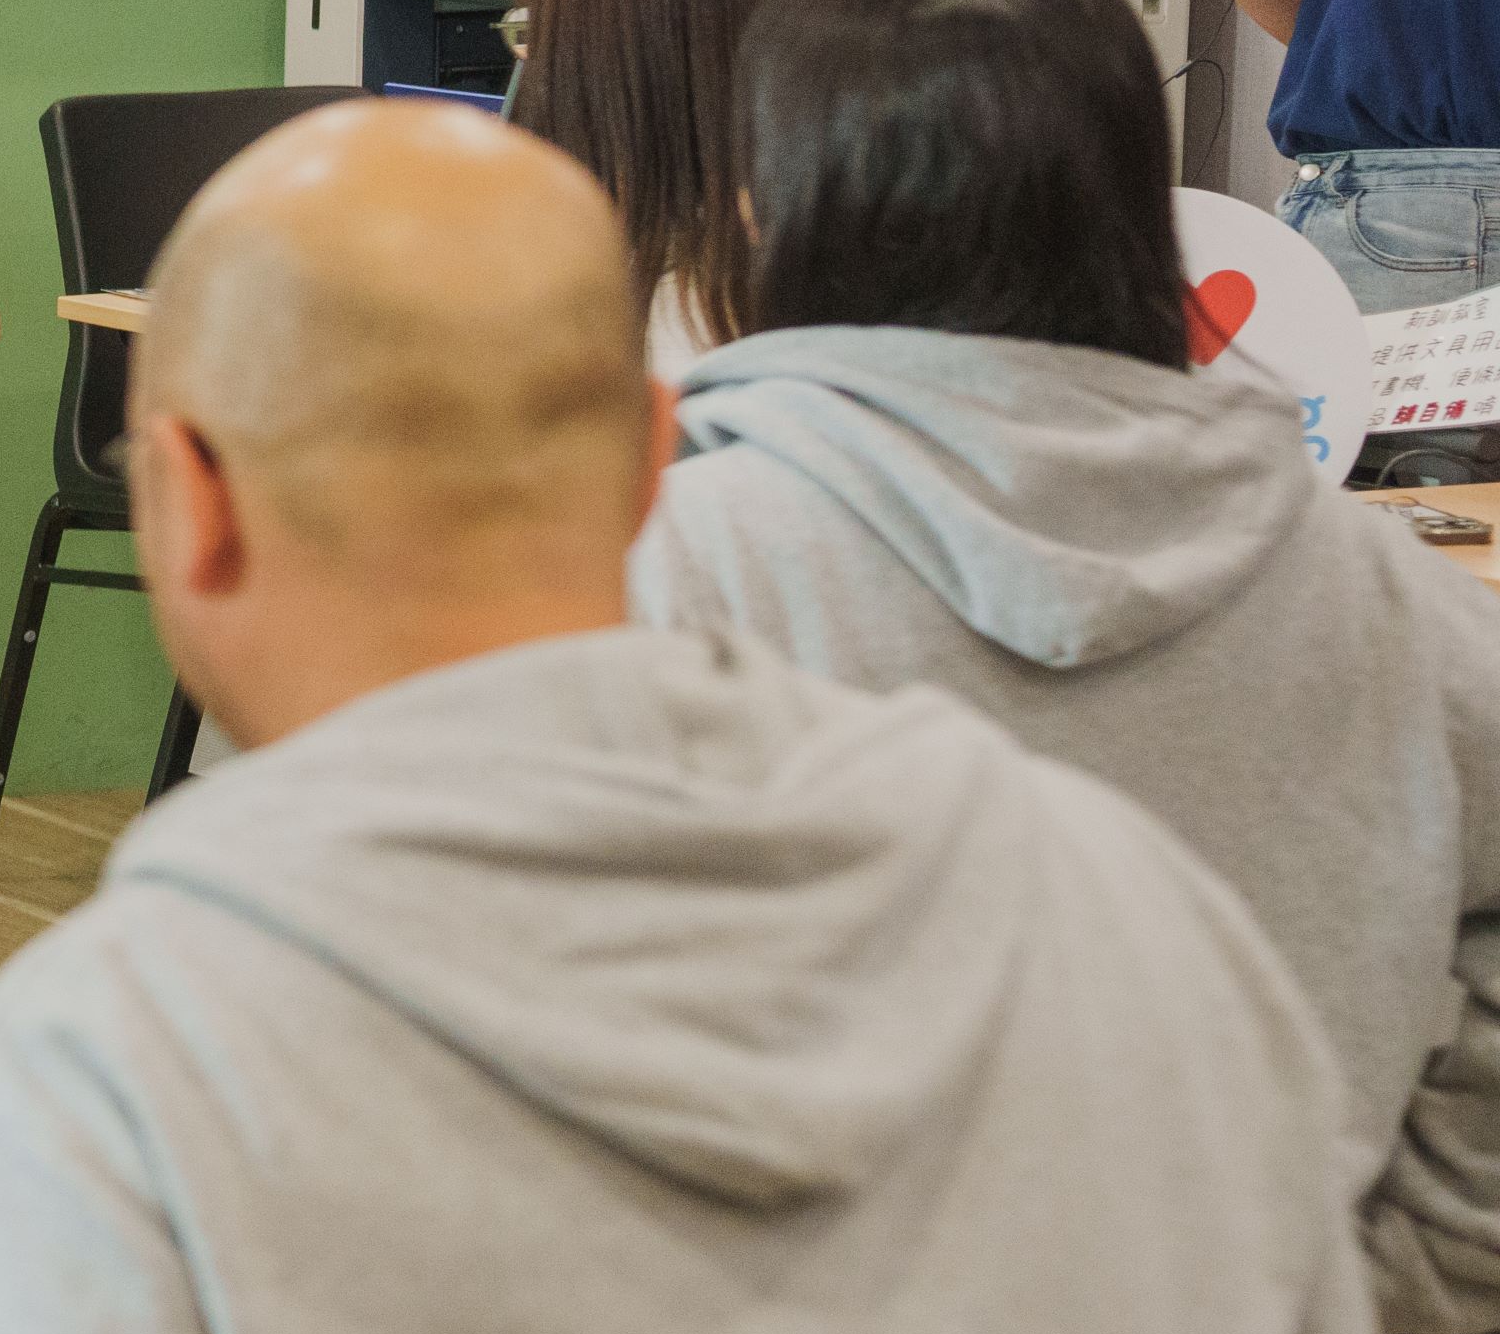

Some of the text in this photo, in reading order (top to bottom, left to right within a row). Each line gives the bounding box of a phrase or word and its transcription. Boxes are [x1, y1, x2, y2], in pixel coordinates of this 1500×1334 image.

[1371, 330, 1500, 366] 提供文具用
